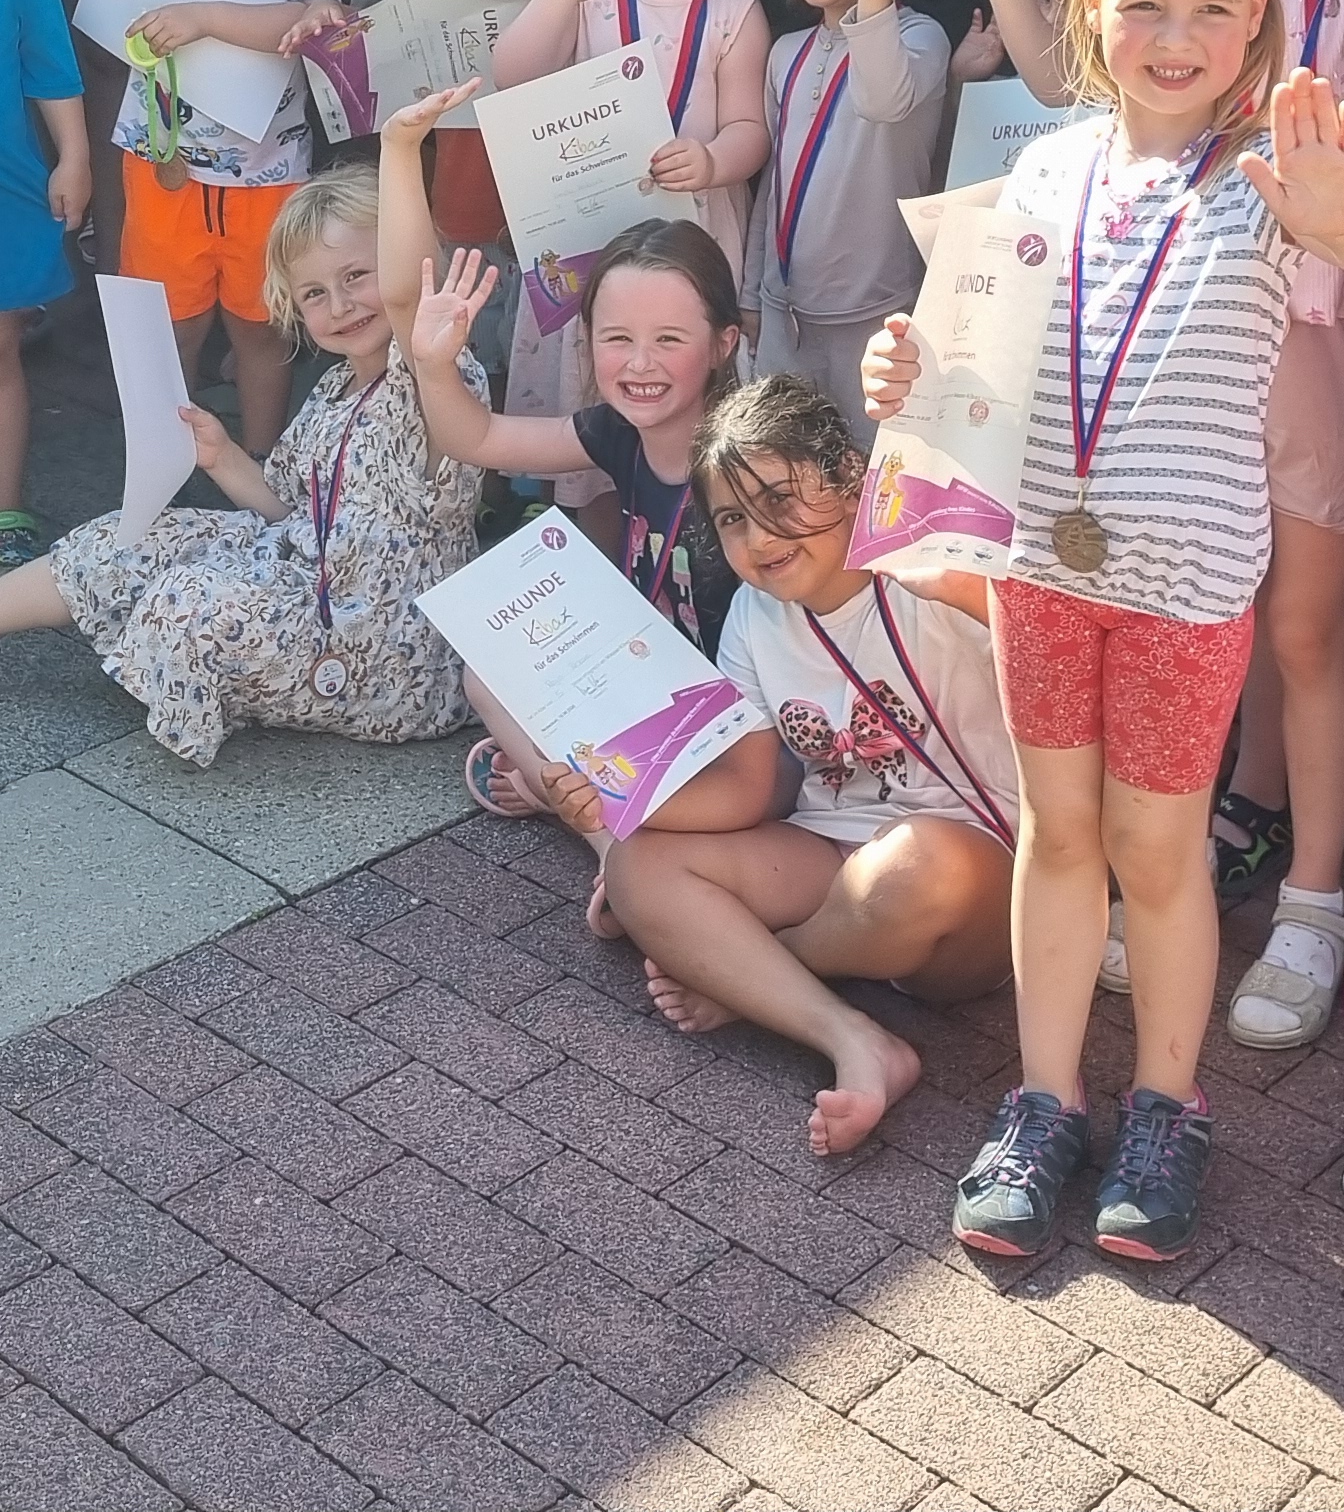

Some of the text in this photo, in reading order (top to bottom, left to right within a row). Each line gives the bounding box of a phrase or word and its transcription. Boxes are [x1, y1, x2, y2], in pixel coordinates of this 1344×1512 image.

[532, 98, 623, 142] URKUNDE
[551, 151, 628, 185] für das Schwimmen
[486, 570, 567, 633] URKUNDE
[533, 621, 601, 673] für das Schwimmen
